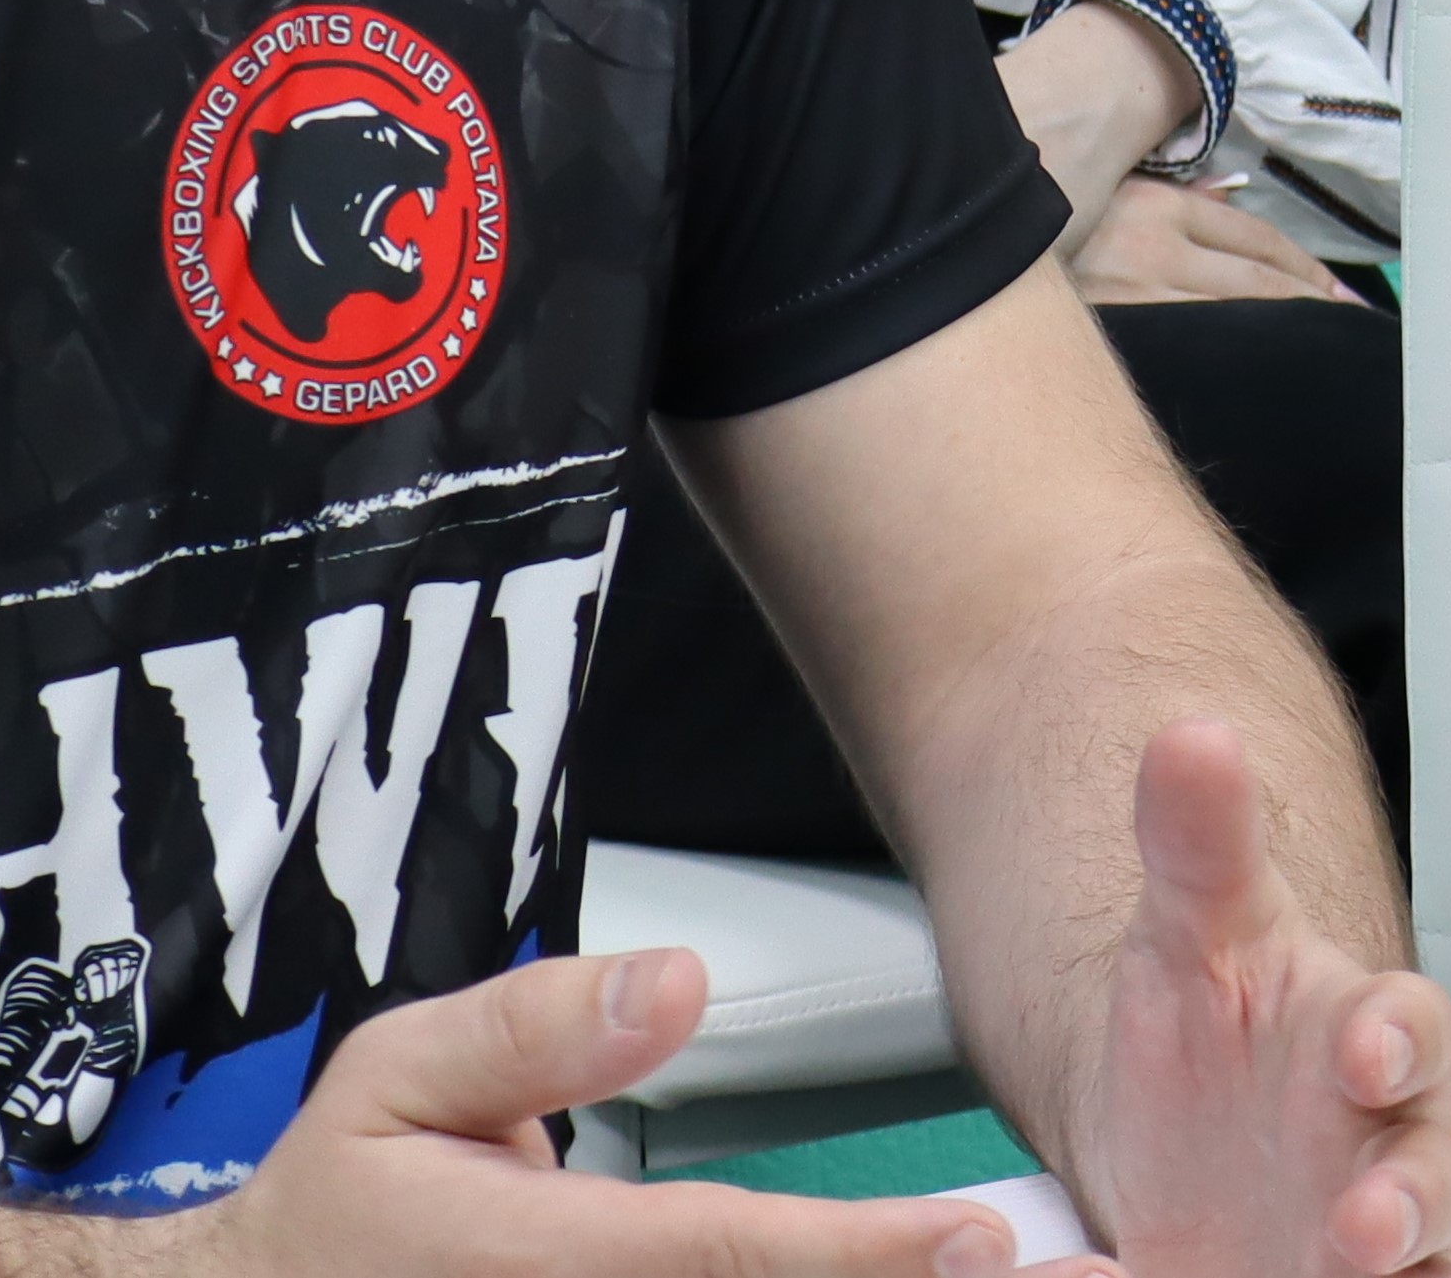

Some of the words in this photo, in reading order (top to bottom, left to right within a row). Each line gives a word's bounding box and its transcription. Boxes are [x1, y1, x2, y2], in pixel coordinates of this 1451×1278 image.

[173, 85, 238, 330] KICKBOXING
[231, 13, 352, 88] SPORTS
[362, 20, 452, 96] CLUB
[447, 91, 501, 263] POLTAVA
[295, 353, 438, 414] GEPARD
